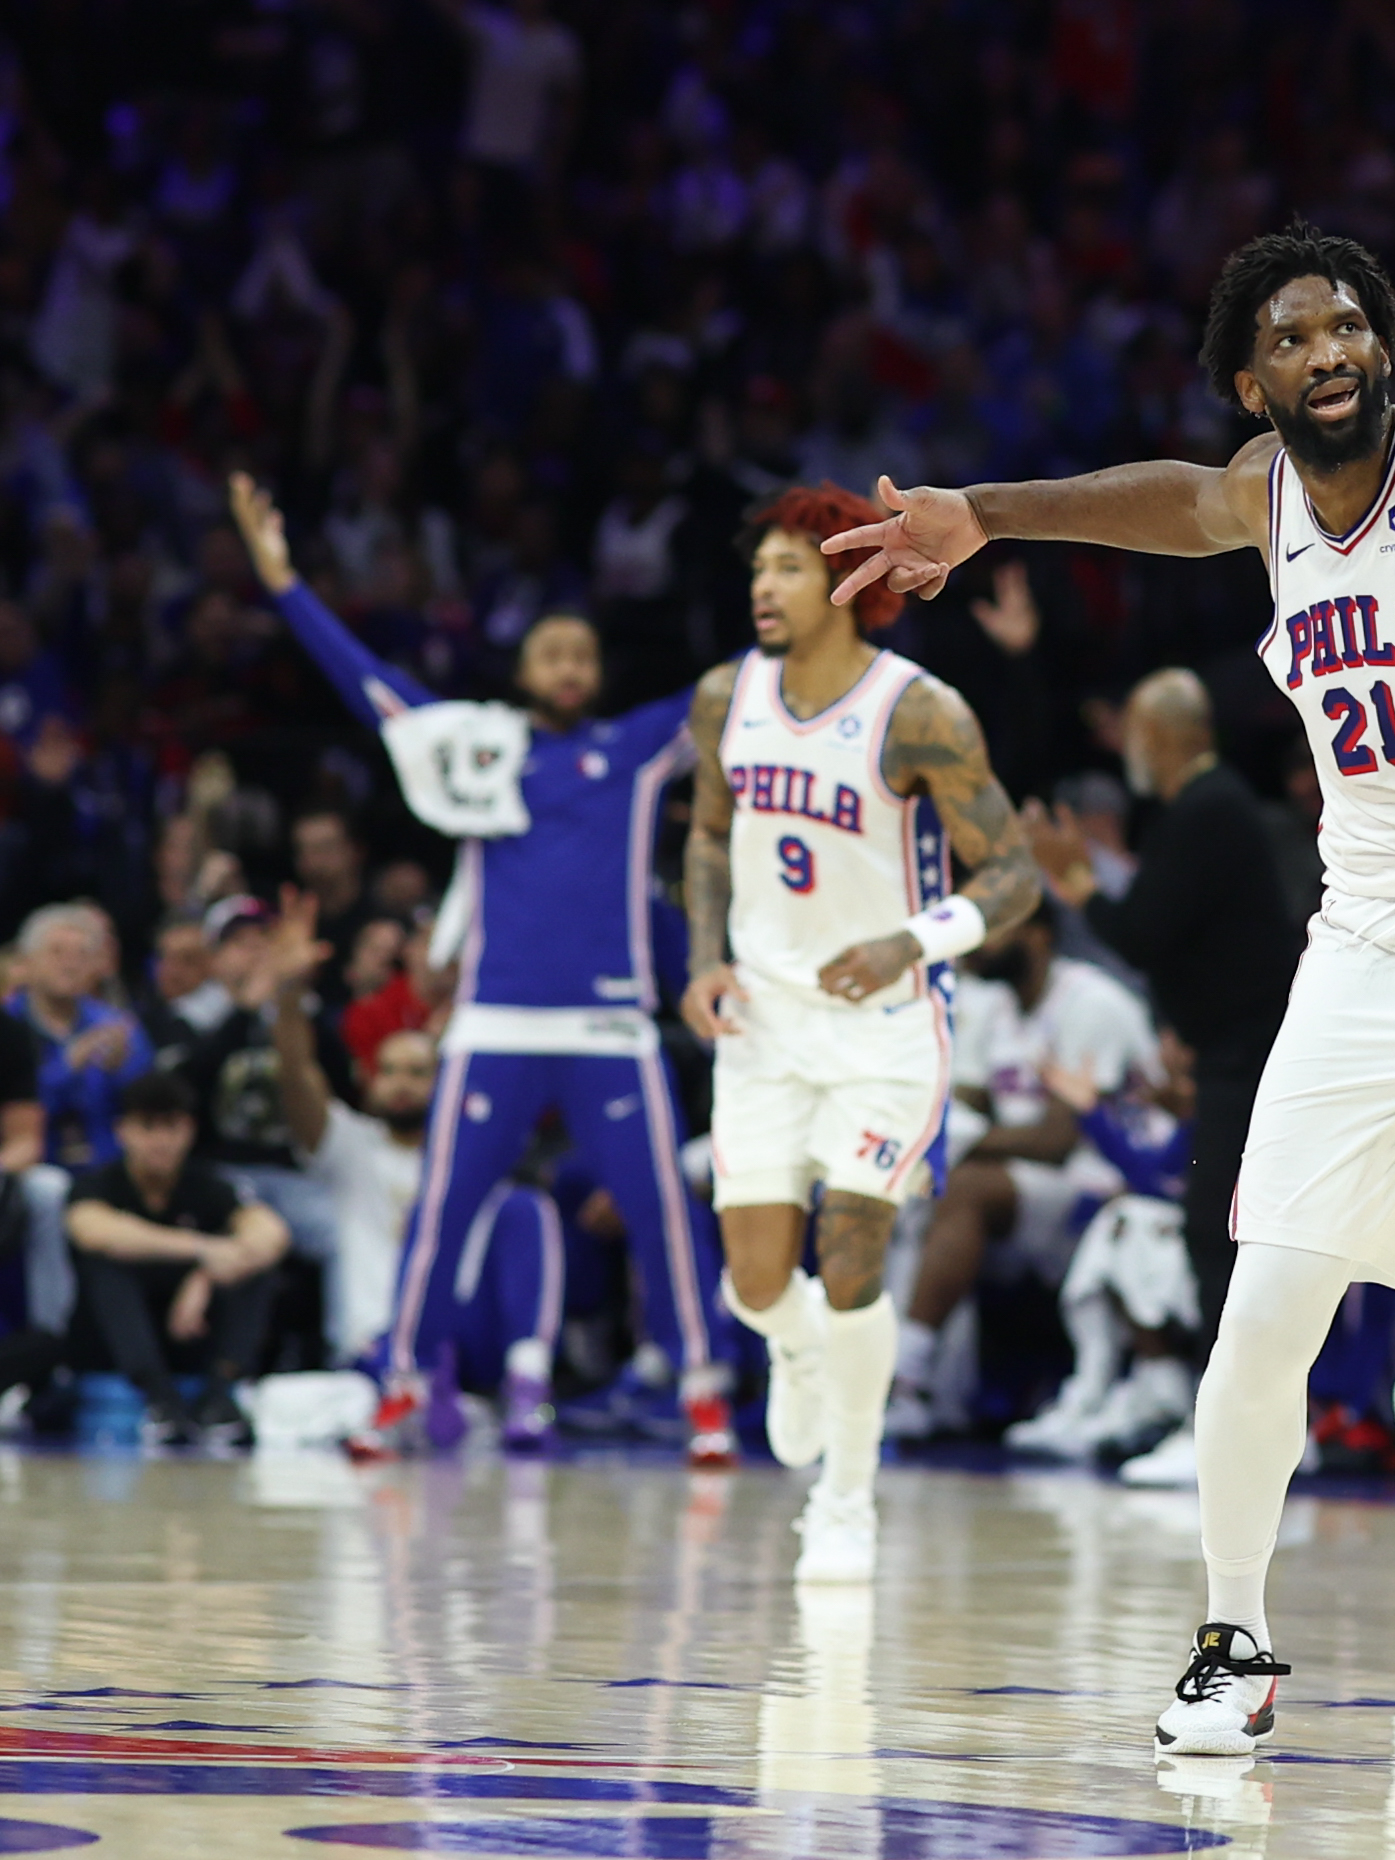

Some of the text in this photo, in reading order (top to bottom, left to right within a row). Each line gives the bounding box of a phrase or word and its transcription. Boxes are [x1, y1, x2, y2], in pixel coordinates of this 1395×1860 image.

[731, 764, 865, 835] PHILA
[777, 834, 817, 895] 9
[857, 1130, 901, 1170] 76
